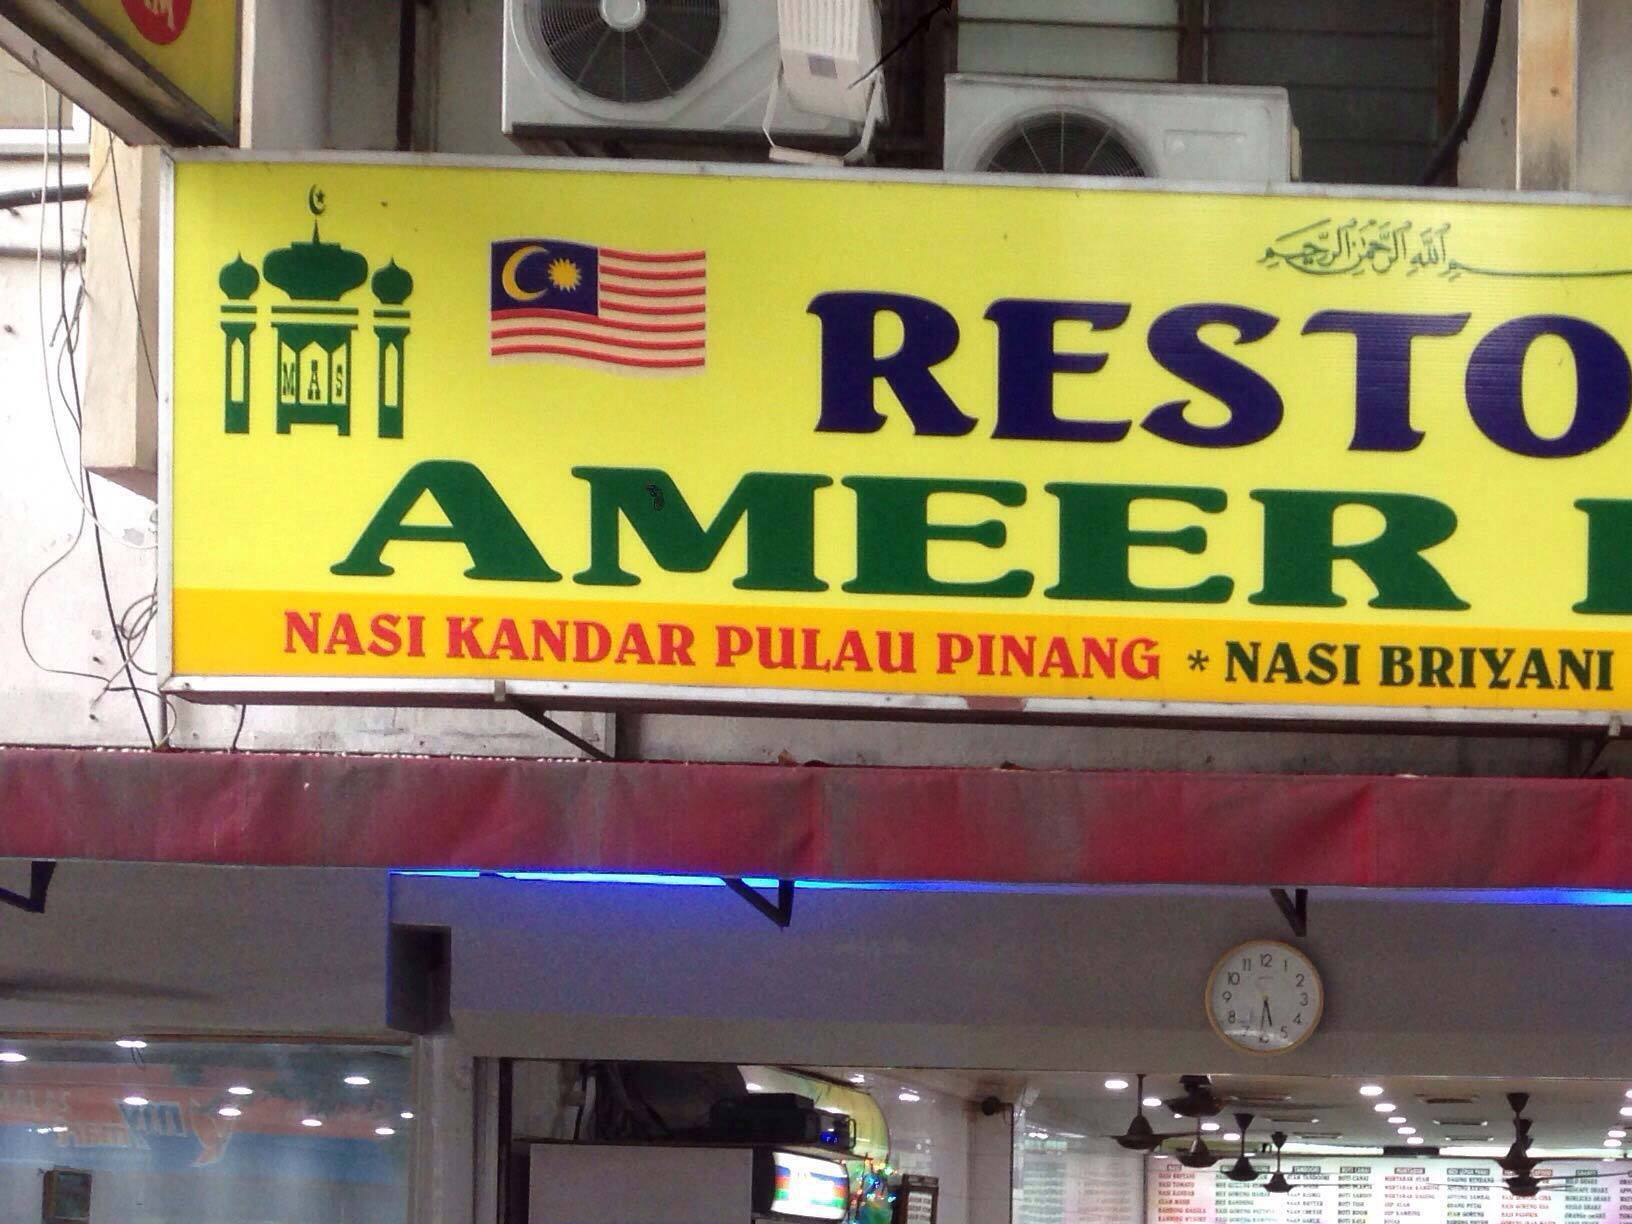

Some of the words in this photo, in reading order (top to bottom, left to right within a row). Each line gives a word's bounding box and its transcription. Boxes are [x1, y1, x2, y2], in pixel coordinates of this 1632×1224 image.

[330, 459, 1472, 613] AMEER
[283, 611, 425, 660] NASI
[447, 614, 698, 668] KANDAR
[716, 623, 916, 676] PULAU
[936, 631, 1162, 681] PINANG
[1225, 640, 1361, 686] NASI
[1380, 643, 1615, 692] BRIYANI
